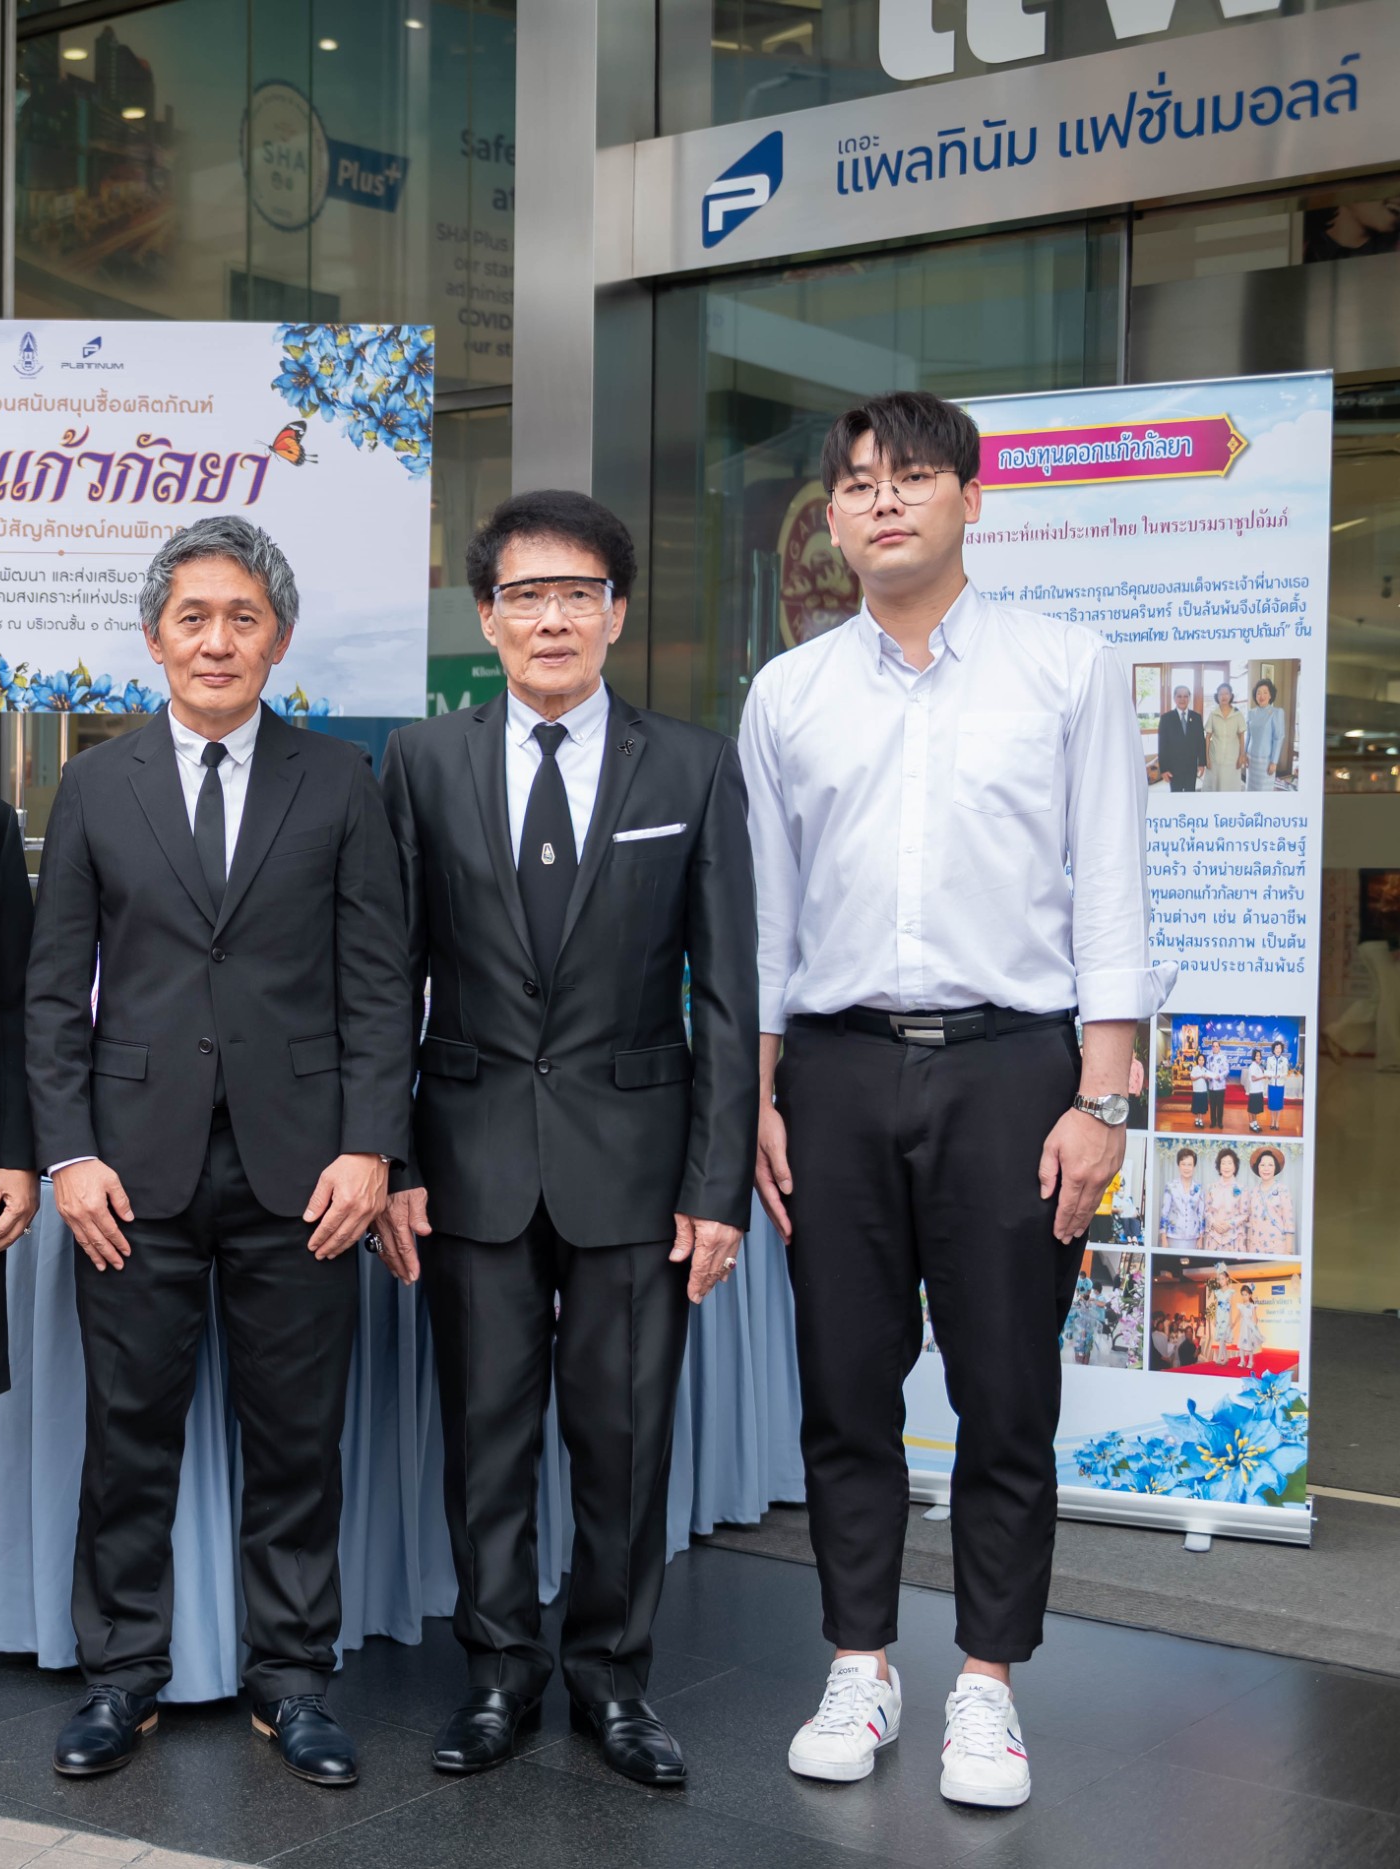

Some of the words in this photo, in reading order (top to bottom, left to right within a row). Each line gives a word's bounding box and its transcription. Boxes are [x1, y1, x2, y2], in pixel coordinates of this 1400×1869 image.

[836, 118, 1037, 195] แพลทินัม
[1058, 53, 1361, 159] แฟชั่นมอลล์
[837, 135, 880, 155] เดอะ
[262, 139, 308, 177] SHA
[60, 362, 124, 370] PLATINUM
[999, 430, 1193, 476] กองทุนดอกแก้วกัลยา
[1141, 507, 1289, 537] ในพระบรมราชูปถัมภ์
[52, 566, 149, 584] และส่งเสริมอา
[7, 620, 23, 631] ณ
[27, 614, 85, 632] บริเวณชั้น
[90, 621, 100, 631] ๑
[1294, 617, 1312, 637] ขึ้น
[1214, 812, 1308, 829] โดยจัดฝึกอบรม
[1192, 860, 1306, 877] จำหน่ายผลิตภัณฑ์
[1263, 884, 1305, 901] สำหรับ
[1213, 909, 1237, 925] เช่น
[1242, 908, 1306, 925] ด้านอาชีพ
[1262, 932, 1306, 950] เป็นต้น
